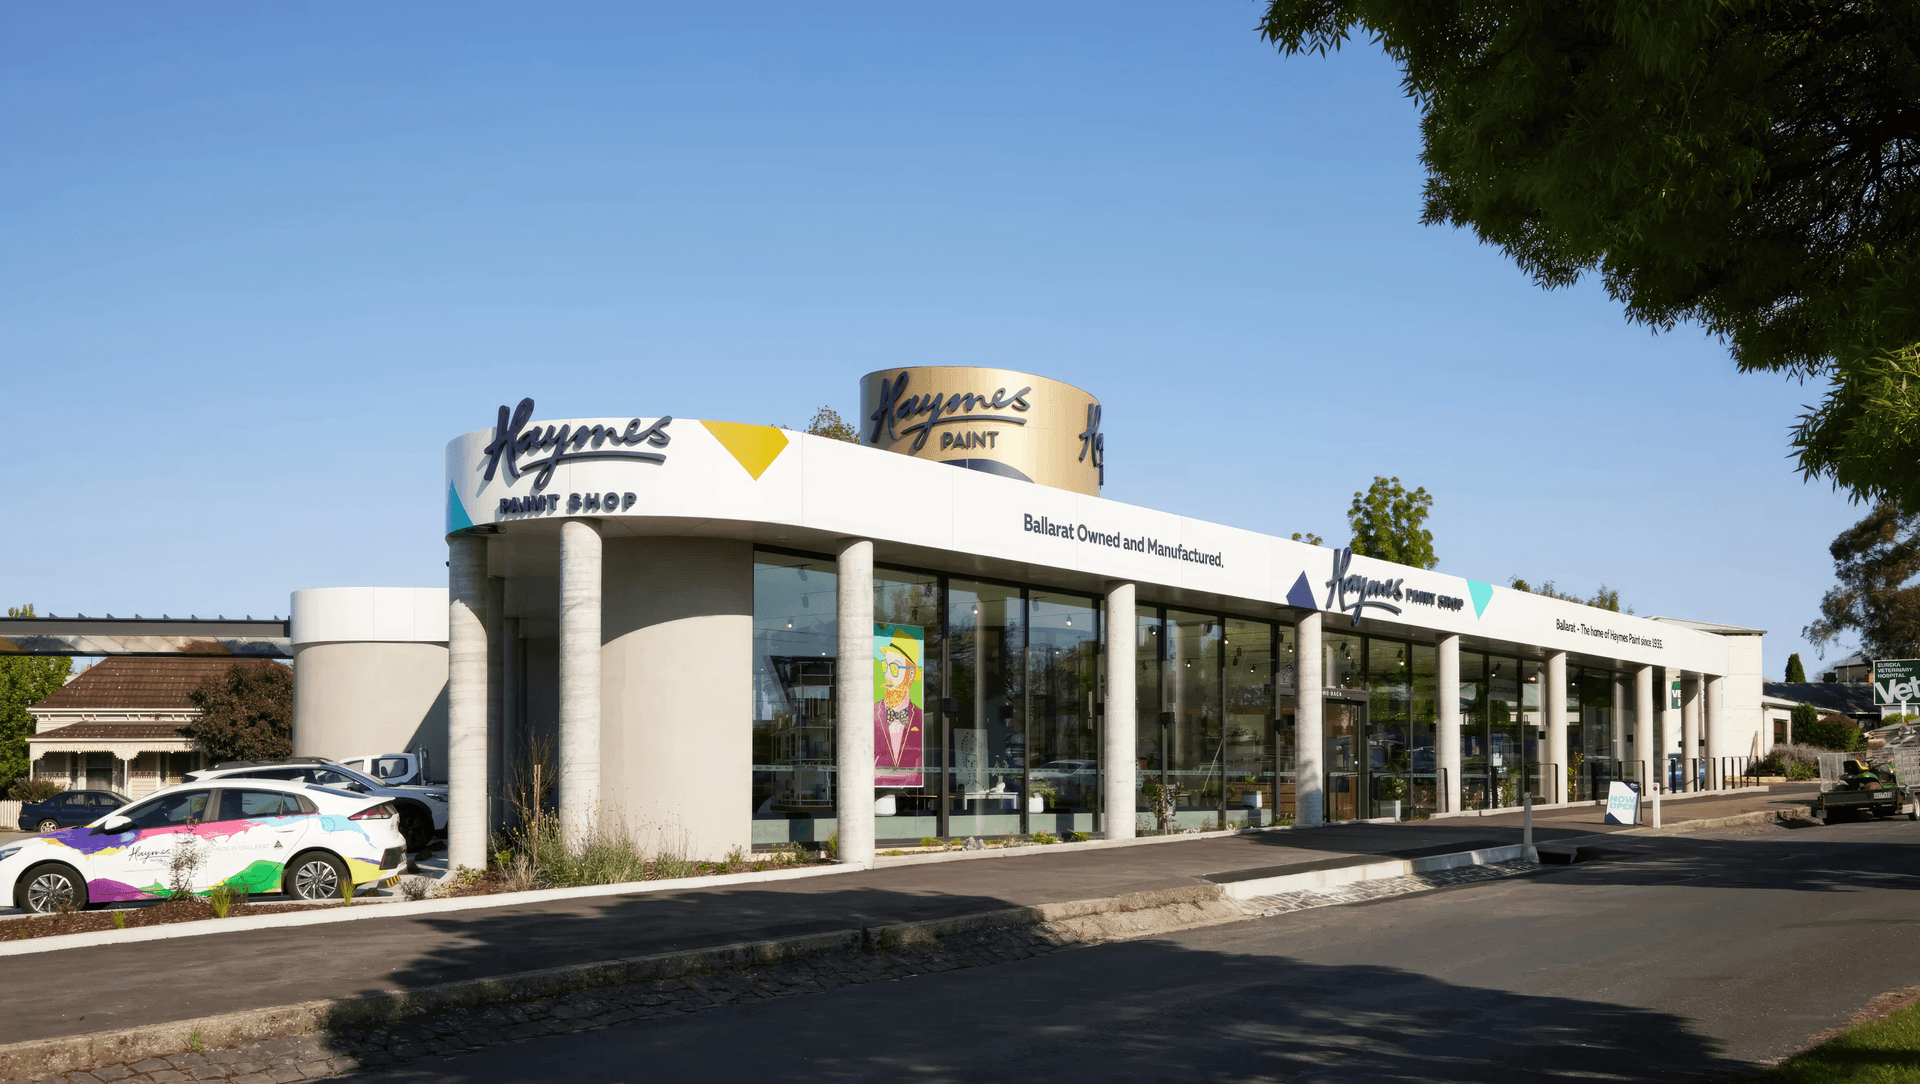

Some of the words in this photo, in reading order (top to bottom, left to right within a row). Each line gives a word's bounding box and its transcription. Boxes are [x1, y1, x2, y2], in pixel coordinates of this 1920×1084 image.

[871, 371, 1031, 450] Haymes
[483, 397, 673, 490] Haymes
[943, 430, 999, 449] PAINT
[499, 494, 560, 515] PAINT
[568, 492, 637, 510] SHOP
[1024, 513, 1075, 540] Ballarat
[1077, 524, 1120, 549] Owned
[1123, 536, 1145, 553] and
[1147, 537, 1224, 569] Manufactured.
[1325, 546, 1404, 627] Haymes
[1405, 588, 1437, 607] PAINT
[1437, 595, 1464, 612] SHOP
[1556, 618, 1576, 633] Ballarat
[1580, 623, 1590, 636] The
[1590, 625, 1604, 639] home
[1604, 629, 1610, 639] of
[1610, 630, 1628, 644] Haymes
[1629, 633, 1641, 645] Paint
[1641, 635, 1652, 647] since
[1875, 676, 1920, 704] Vet
[1609, 802, 1635, 810] OPEN
[1610, 795, 1635, 803] NOW
[128, 845, 171, 865] Haymes
